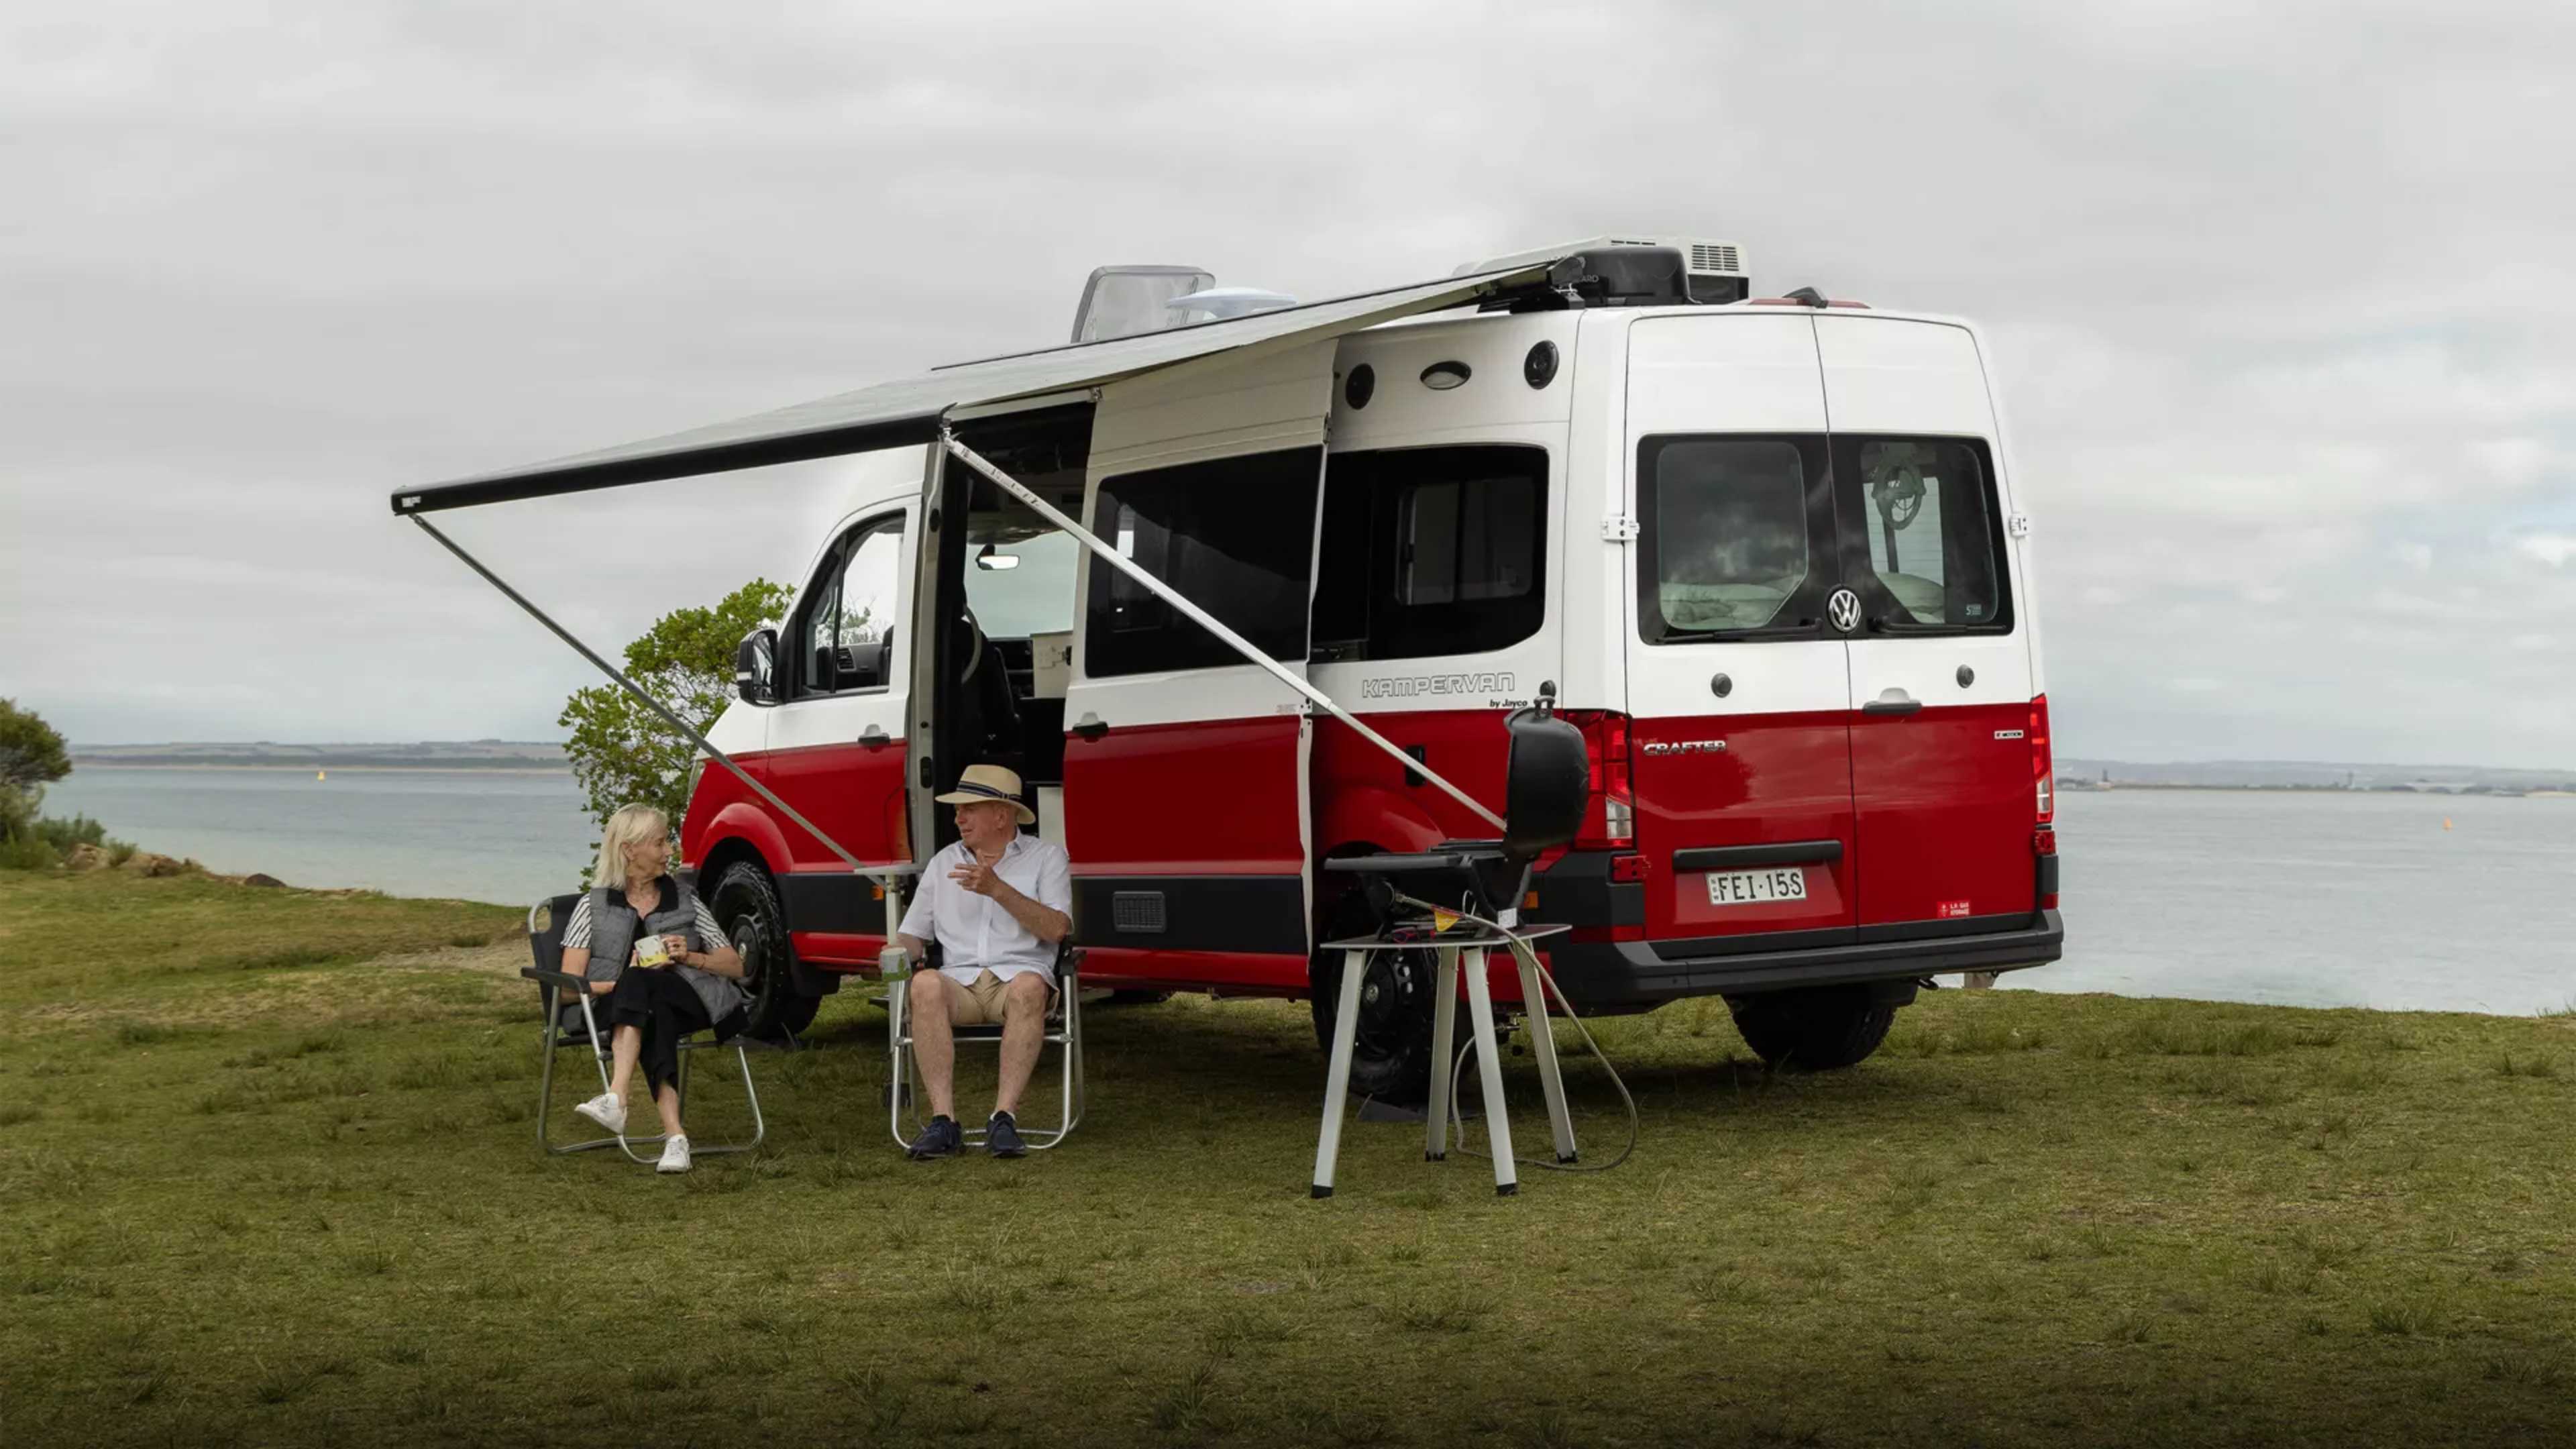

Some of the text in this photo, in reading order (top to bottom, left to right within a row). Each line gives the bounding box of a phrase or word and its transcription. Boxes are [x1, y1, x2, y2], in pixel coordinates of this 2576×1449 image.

[1362, 672, 1515, 698] KAMPERVAN
[1489, 698, 1528, 708] by Jayco
[1643, 740, 1726, 756] CRAFTER
